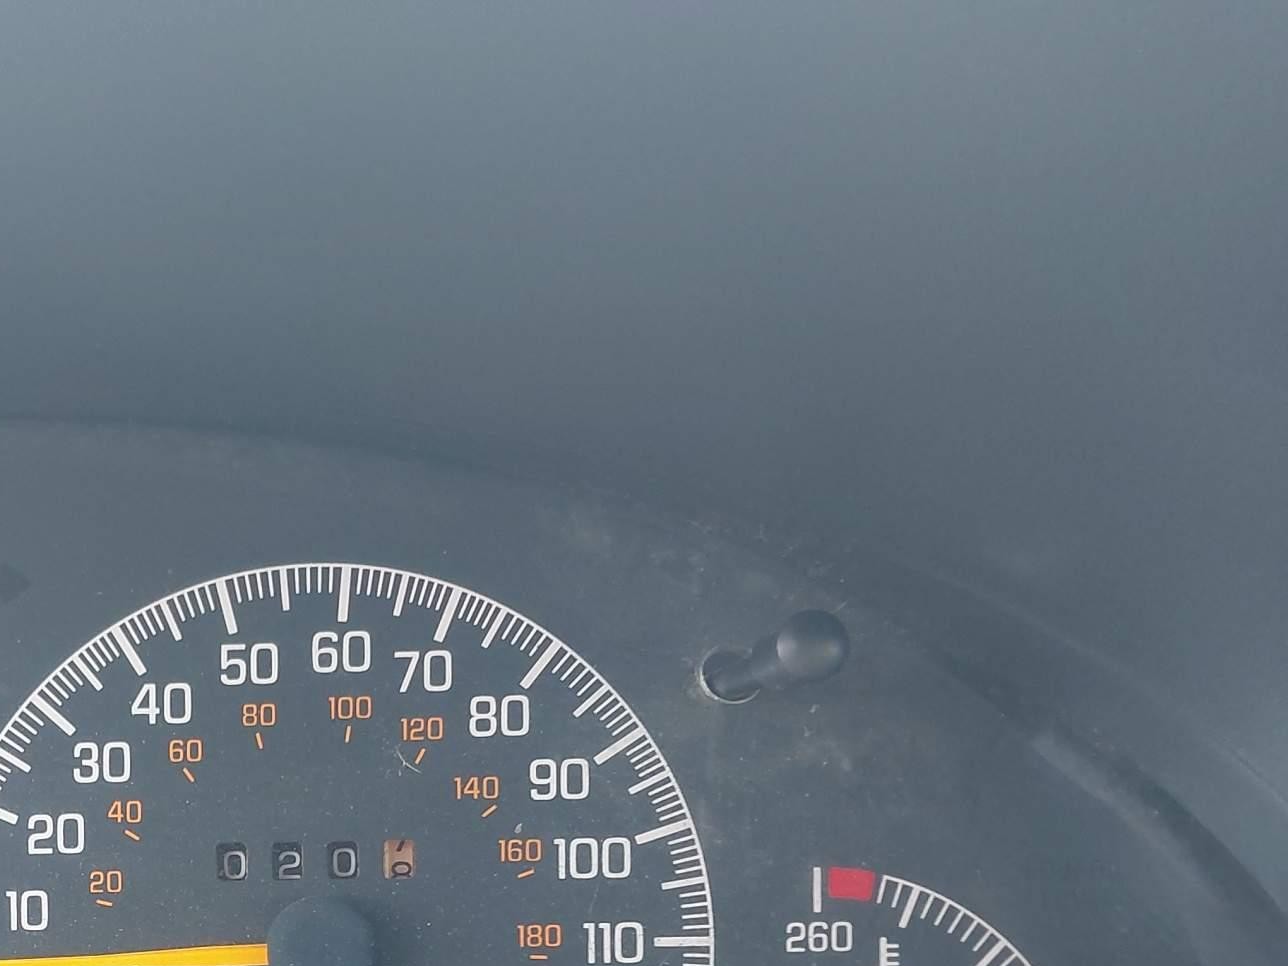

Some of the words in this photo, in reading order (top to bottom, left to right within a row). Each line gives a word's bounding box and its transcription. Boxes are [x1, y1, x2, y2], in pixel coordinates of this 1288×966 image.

[220, 642, 279, 686] 50
[311, 630, 371, 673] 60
[394, 649, 452, 693] 70
[131, 682, 192, 725] 40
[242, 703, 276, 726] 80
[328, 696, 372, 720] 100
[469, 694, 530, 738] 80
[400, 717, 443, 741] 120
[73, 741, 131, 784] 30
[169, 739, 202, 763] 60
[454, 776, 499, 800] 140
[529, 758, 590, 801] 90
[107, 800, 142, 823] 40
[27, 813, 85, 855] 20
[498, 839, 542, 862] 160
[553, 837, 631, 880] 100
[90, 870, 122, 893] 20
[5, 890, 49, 931] 10
[517, 924, 561, 947] 180
[583, 921, 644, 964] 110
[786, 921, 853, 953] 260
